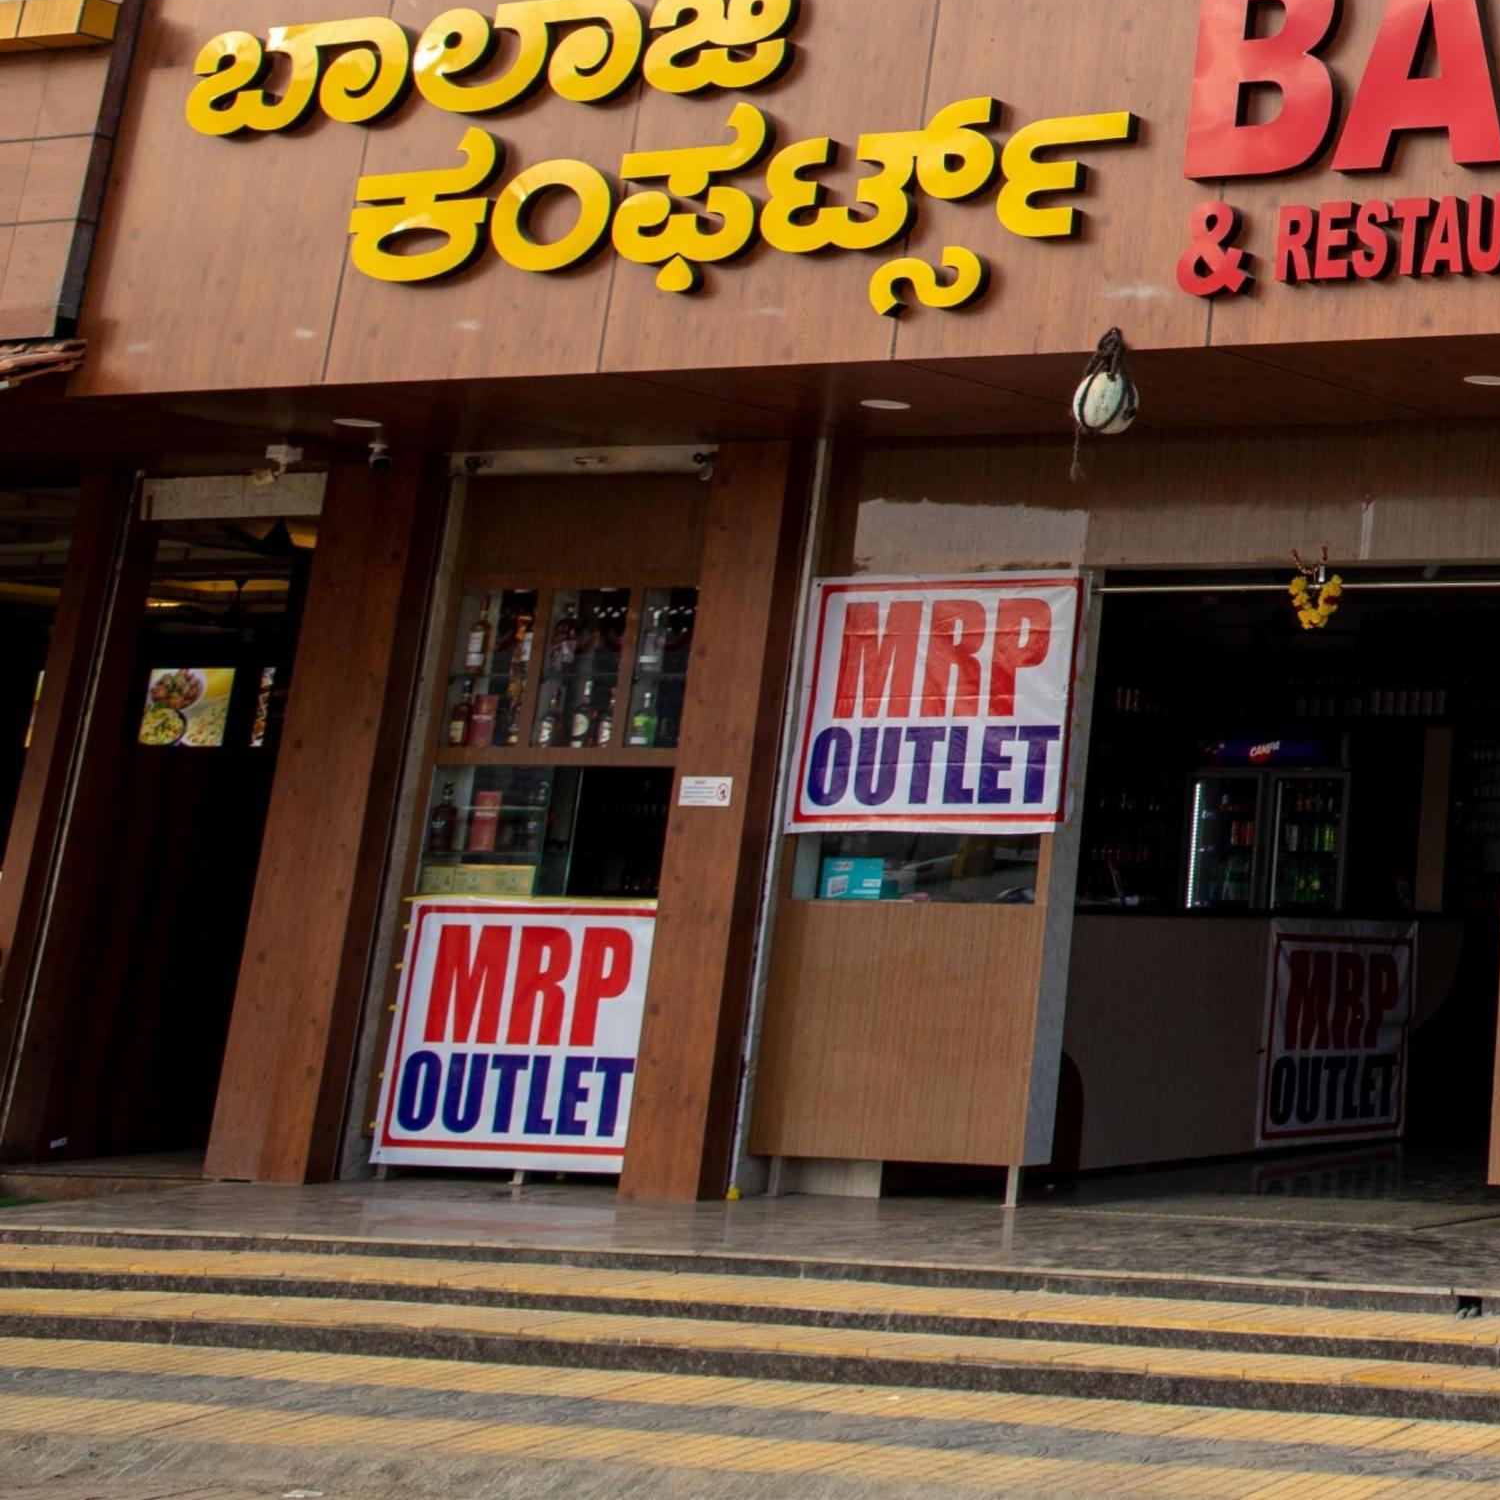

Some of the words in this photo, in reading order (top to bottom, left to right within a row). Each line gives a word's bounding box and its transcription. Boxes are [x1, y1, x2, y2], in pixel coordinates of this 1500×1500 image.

[1176, 200, 1254, 299] &
[832, 597, 1053, 720] MRP
[806, 724, 1061, 808] OUTLET
[423, 924, 634, 1047] MRP
[1285, 950, 1399, 1050] MRP
[396, 1050, 636, 1138] OUTLET
[1269, 1053, 1398, 1126] OUTLET
